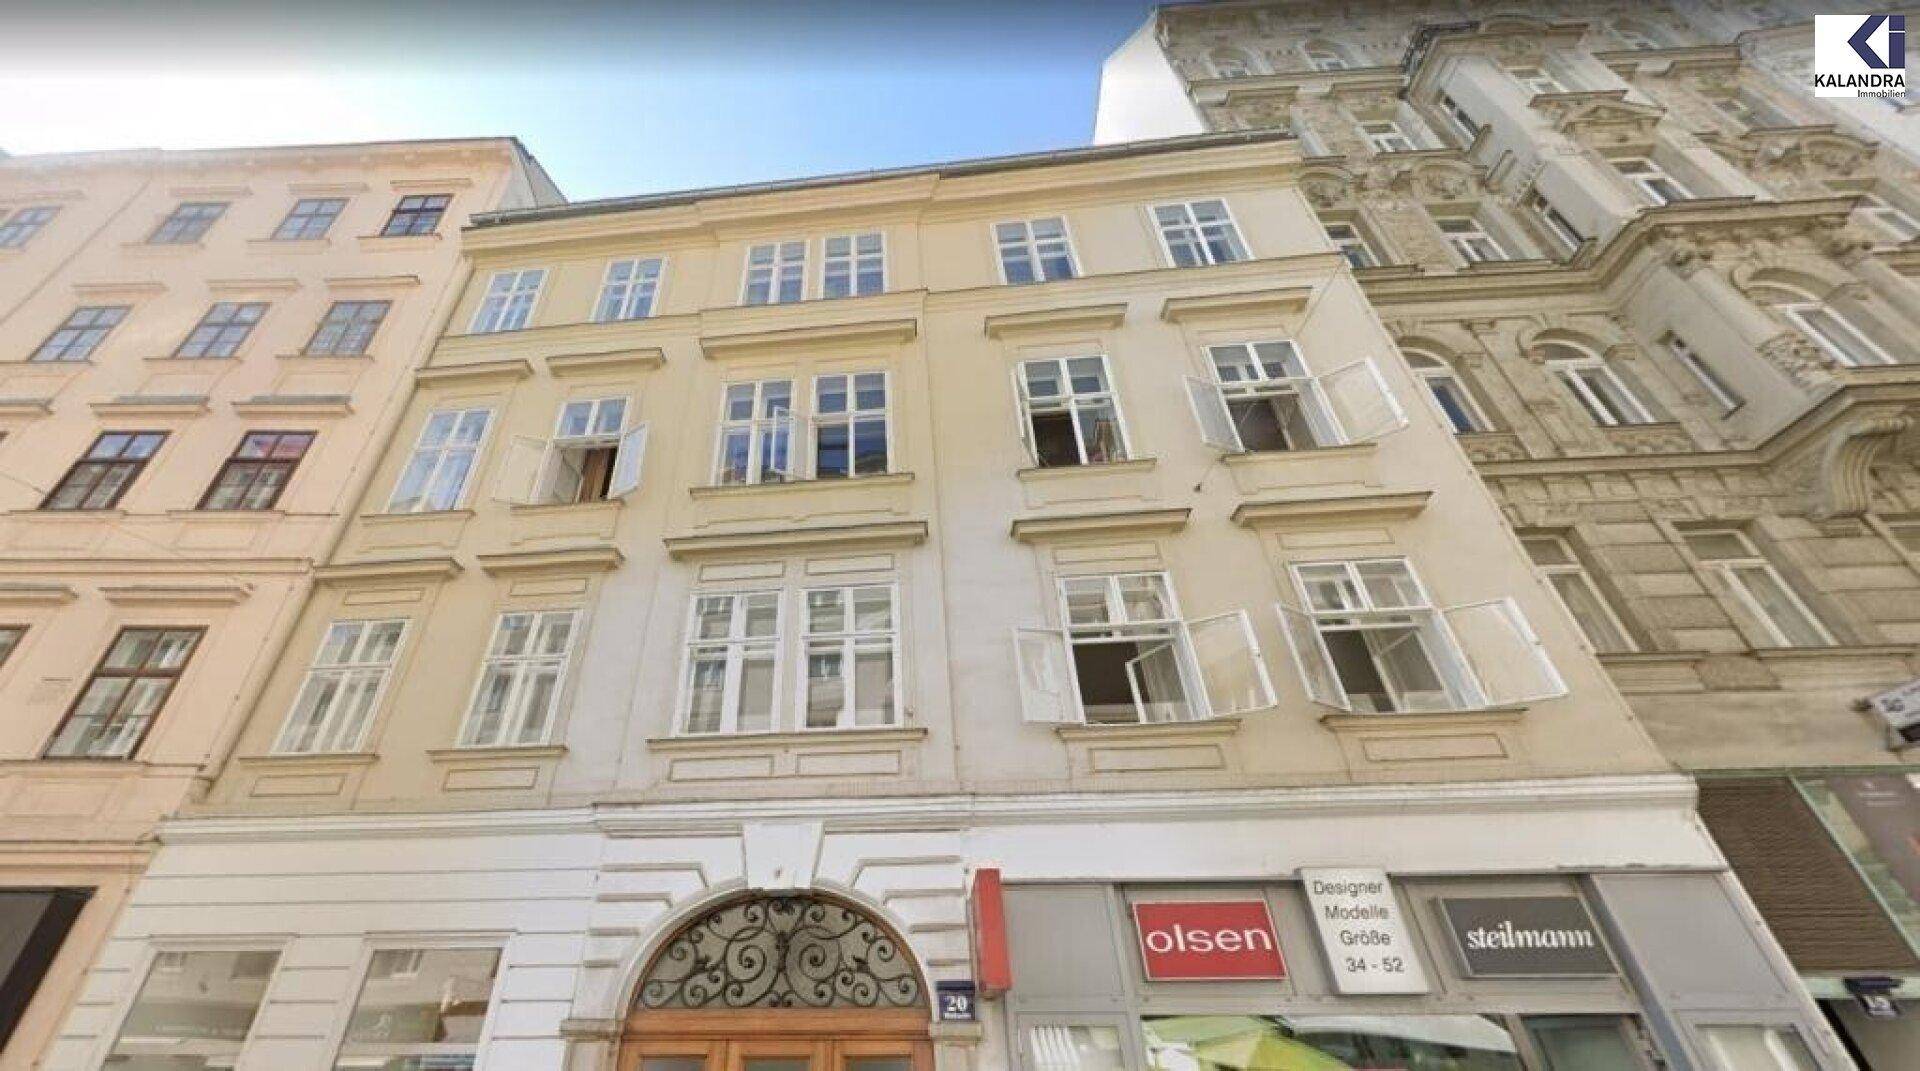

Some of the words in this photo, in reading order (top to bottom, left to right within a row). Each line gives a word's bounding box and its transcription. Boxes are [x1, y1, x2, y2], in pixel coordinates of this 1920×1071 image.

[1313, 881, 1383, 897] Designer
[1324, 904, 1389, 920] Modelle
[1146, 923, 1272, 953] olsen
[1340, 929, 1391, 946] Größe
[1467, 920, 1595, 949] steilmann
[1345, 957, 1366, 973] 34
[1382, 956, 1404, 973] 52
[944, 995, 968, 1012] 20
